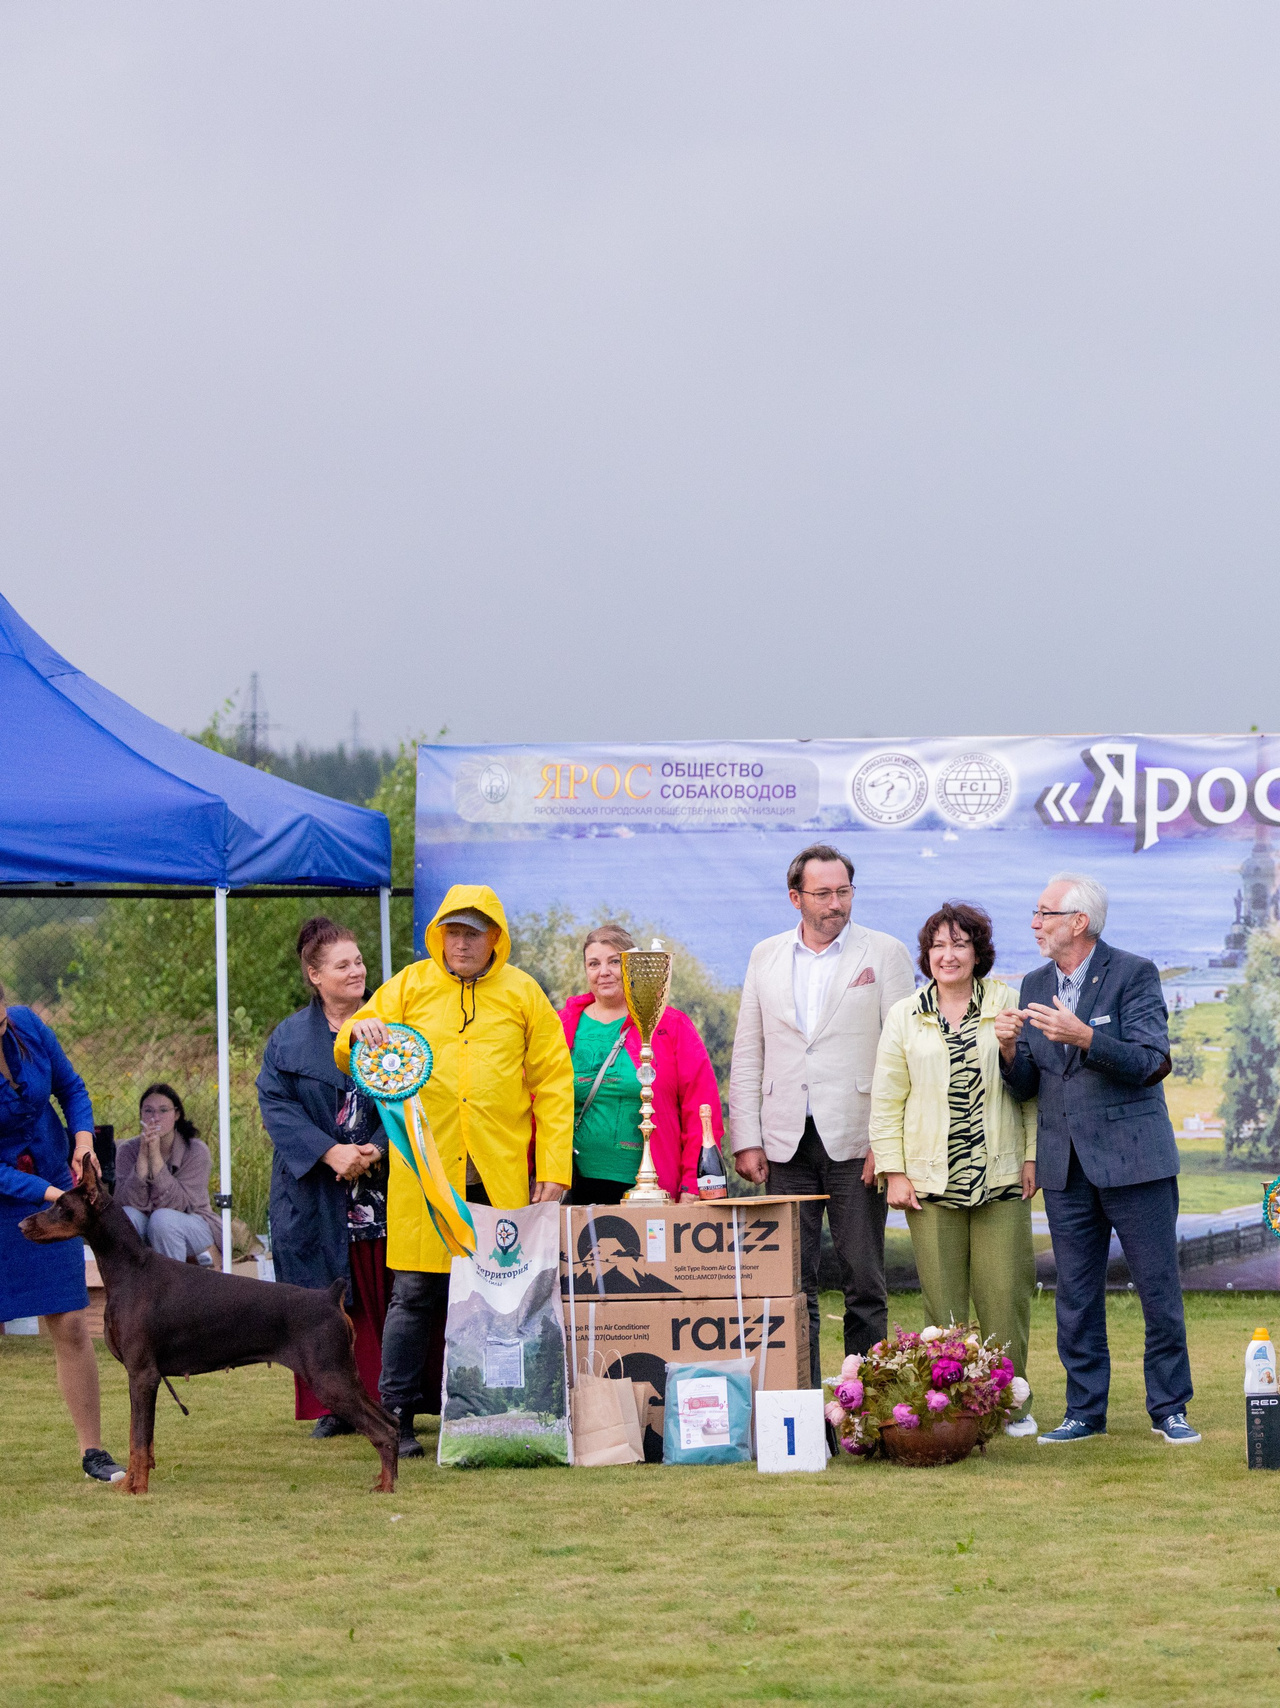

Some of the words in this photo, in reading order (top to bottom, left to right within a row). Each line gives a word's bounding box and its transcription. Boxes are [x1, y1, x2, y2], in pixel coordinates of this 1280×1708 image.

[661, 762, 764, 780] ОБЩЕСТВО
[533, 763, 652, 800] ЯРОС
[660, 784, 797, 801] СОБАКОВОДОВ
[534, 806, 598, 816] ЯРОСЛАВСКАЯ
[600, 806, 652, 816] ГОРОДСКАЯ
[654, 806, 728, 816] ОБЩЕСТВЕННАЯ
[673, 1219, 780, 1255] razz
[687, 1265, 700, 1273] Type
[718, 1273, 736, 1281] (Indoo
[569, 1324, 583, 1332] Tpe
[584, 1324, 603, 1332] Rom
[613, 1323, 650, 1331] Conditioner
[671, 1314, 786, 1352] razz
[633, 1333, 650, 1341] Unit)
[783, 1416, 796, 1456] 1
